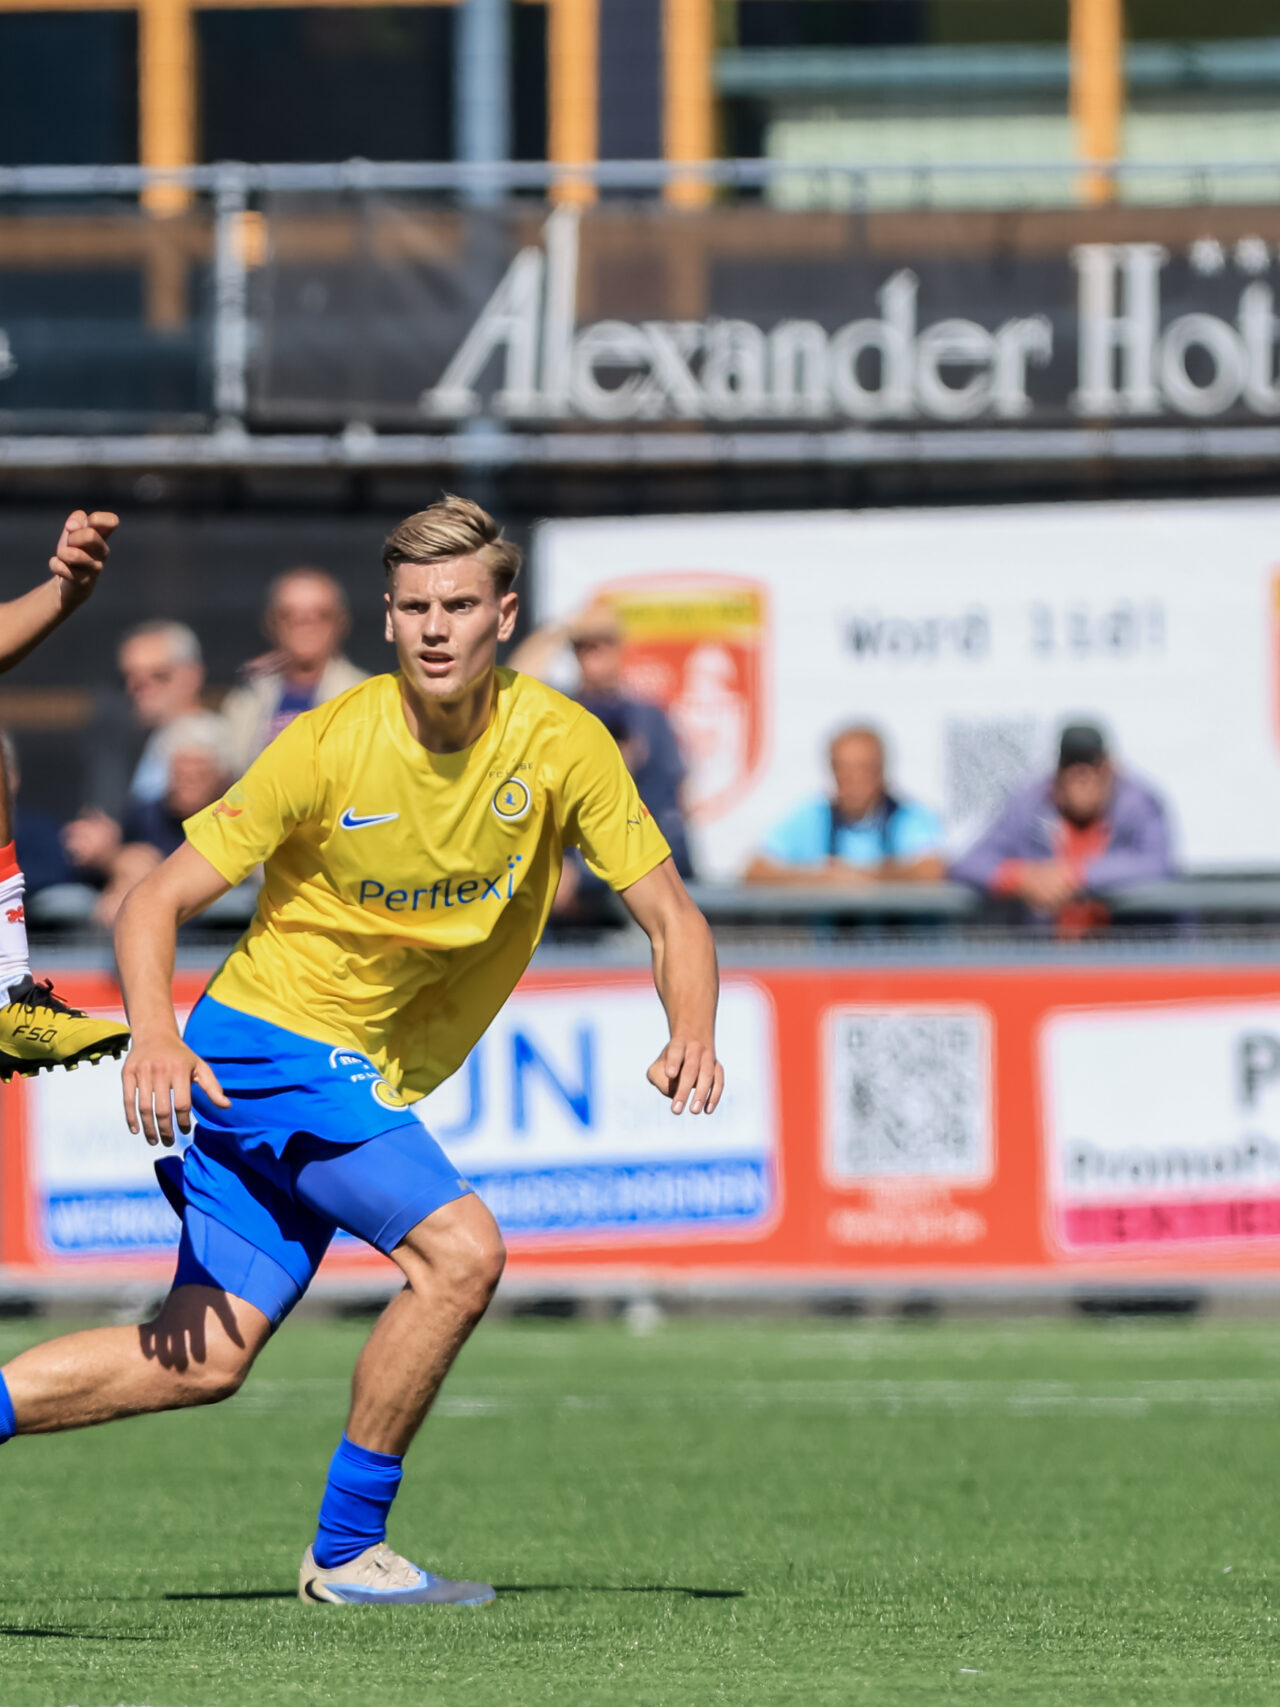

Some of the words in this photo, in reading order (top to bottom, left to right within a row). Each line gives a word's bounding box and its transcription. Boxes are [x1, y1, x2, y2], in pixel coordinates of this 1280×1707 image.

[423, 203, 1053, 420] Alexander
[836, 602, 990, 661] Word
[359, 855, 522, 912] Perflexi
[12, 1024, 58, 1044] F50
[1066, 1134, 1280, 1184] PromoP
